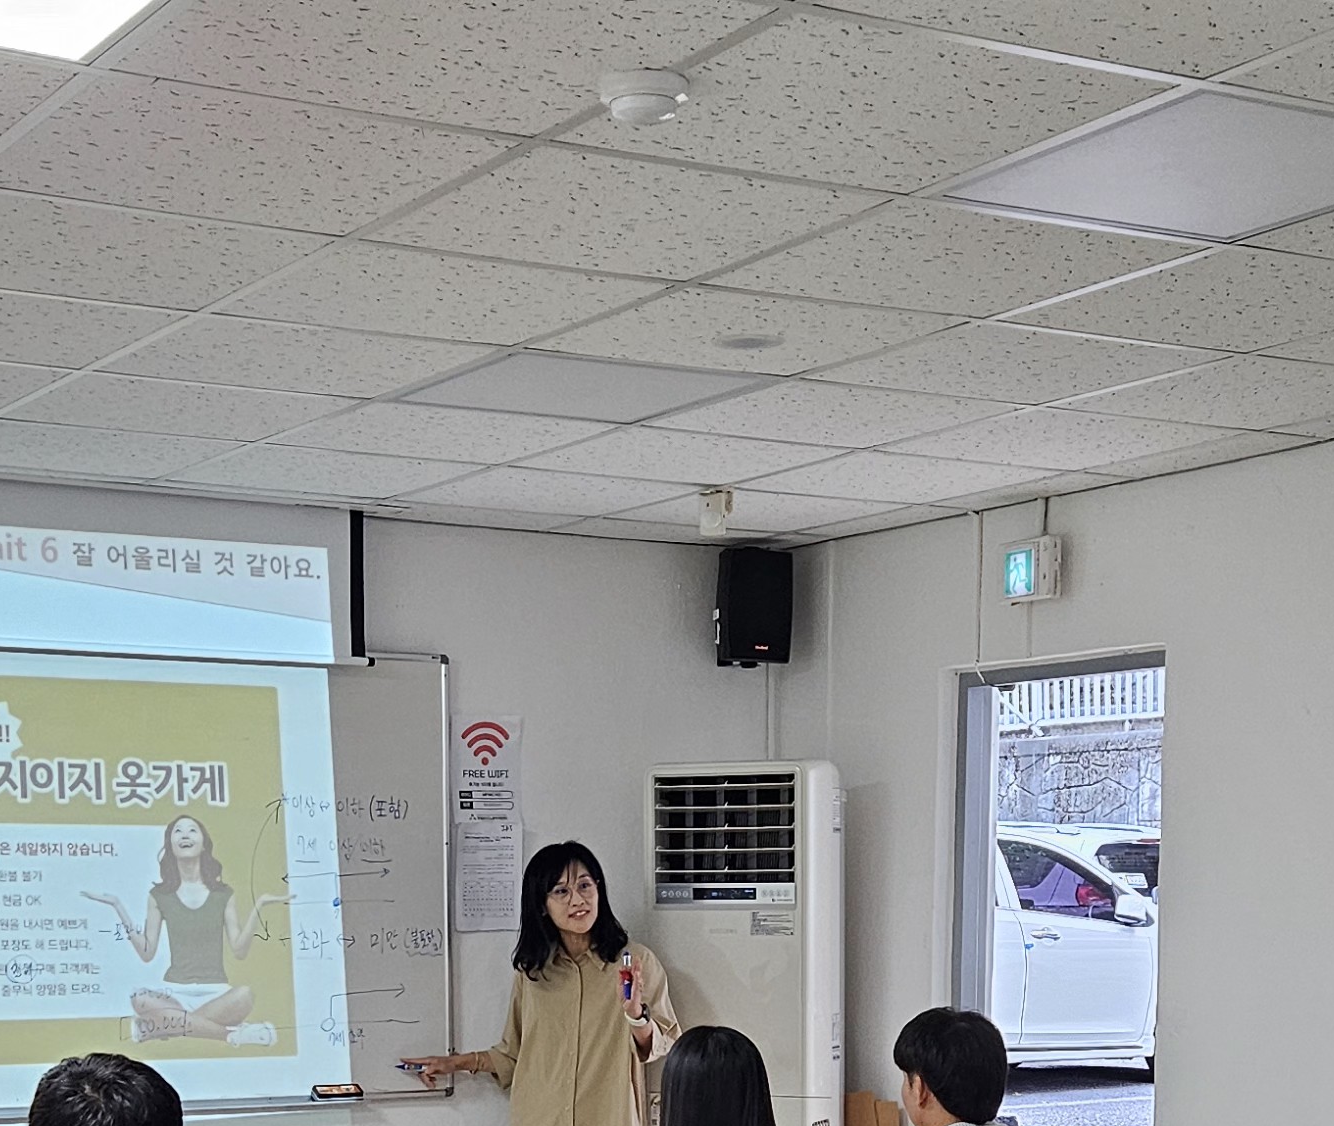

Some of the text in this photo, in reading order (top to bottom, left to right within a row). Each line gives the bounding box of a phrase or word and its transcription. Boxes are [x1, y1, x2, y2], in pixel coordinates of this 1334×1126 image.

[40, 536, 59, 564] 6
[72, 540, 95, 568] 잘
[107, 544, 202, 574] 어울리실
[214, 551, 235, 576] 것
[246, 553, 321, 580] 같아요.
[462, 769, 486, 778] FREE
[115, 760, 226, 805] 옷가게
[15, 842, 63, 857] 세일하지
[67, 843, 118, 857] 않습니다.
[25, 895, 42, 906] OK
